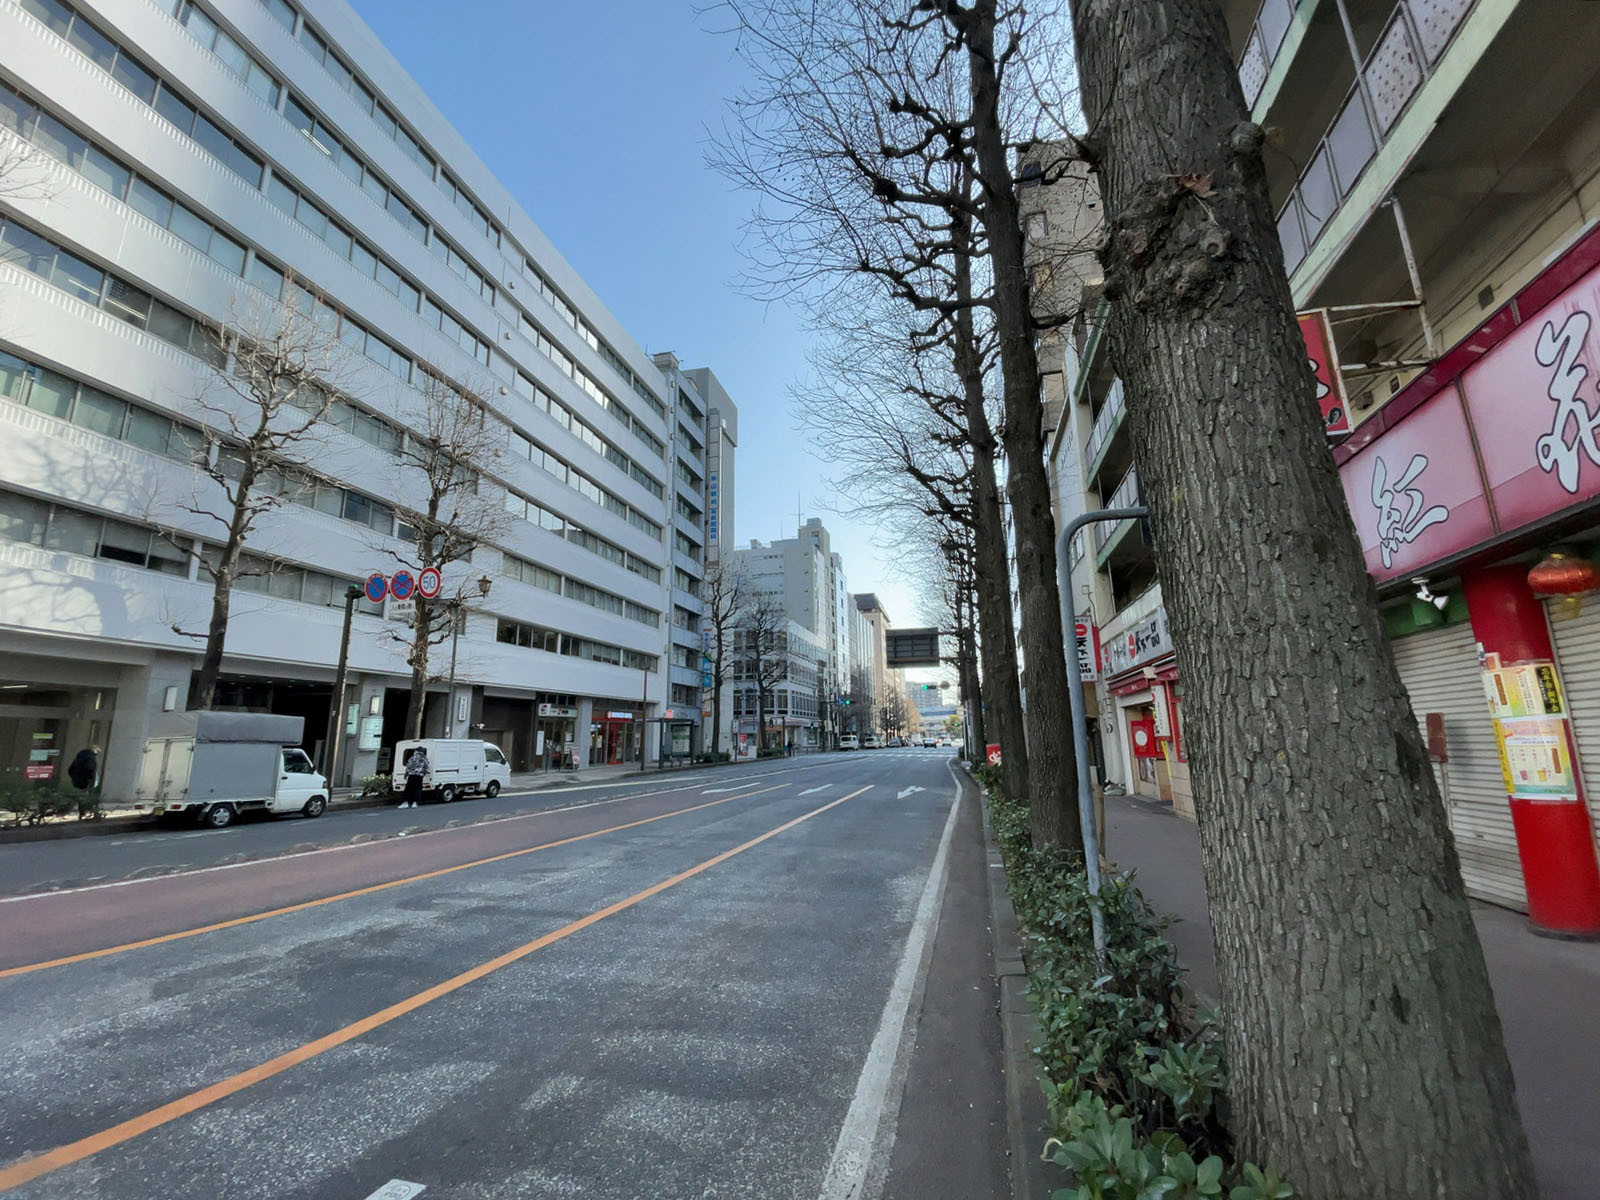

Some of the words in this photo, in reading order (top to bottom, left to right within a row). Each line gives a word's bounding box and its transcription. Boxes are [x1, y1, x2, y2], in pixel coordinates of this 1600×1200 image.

[423, 575, 436, 590] 50
[1135, 620, 1160, 655] 天下一品
